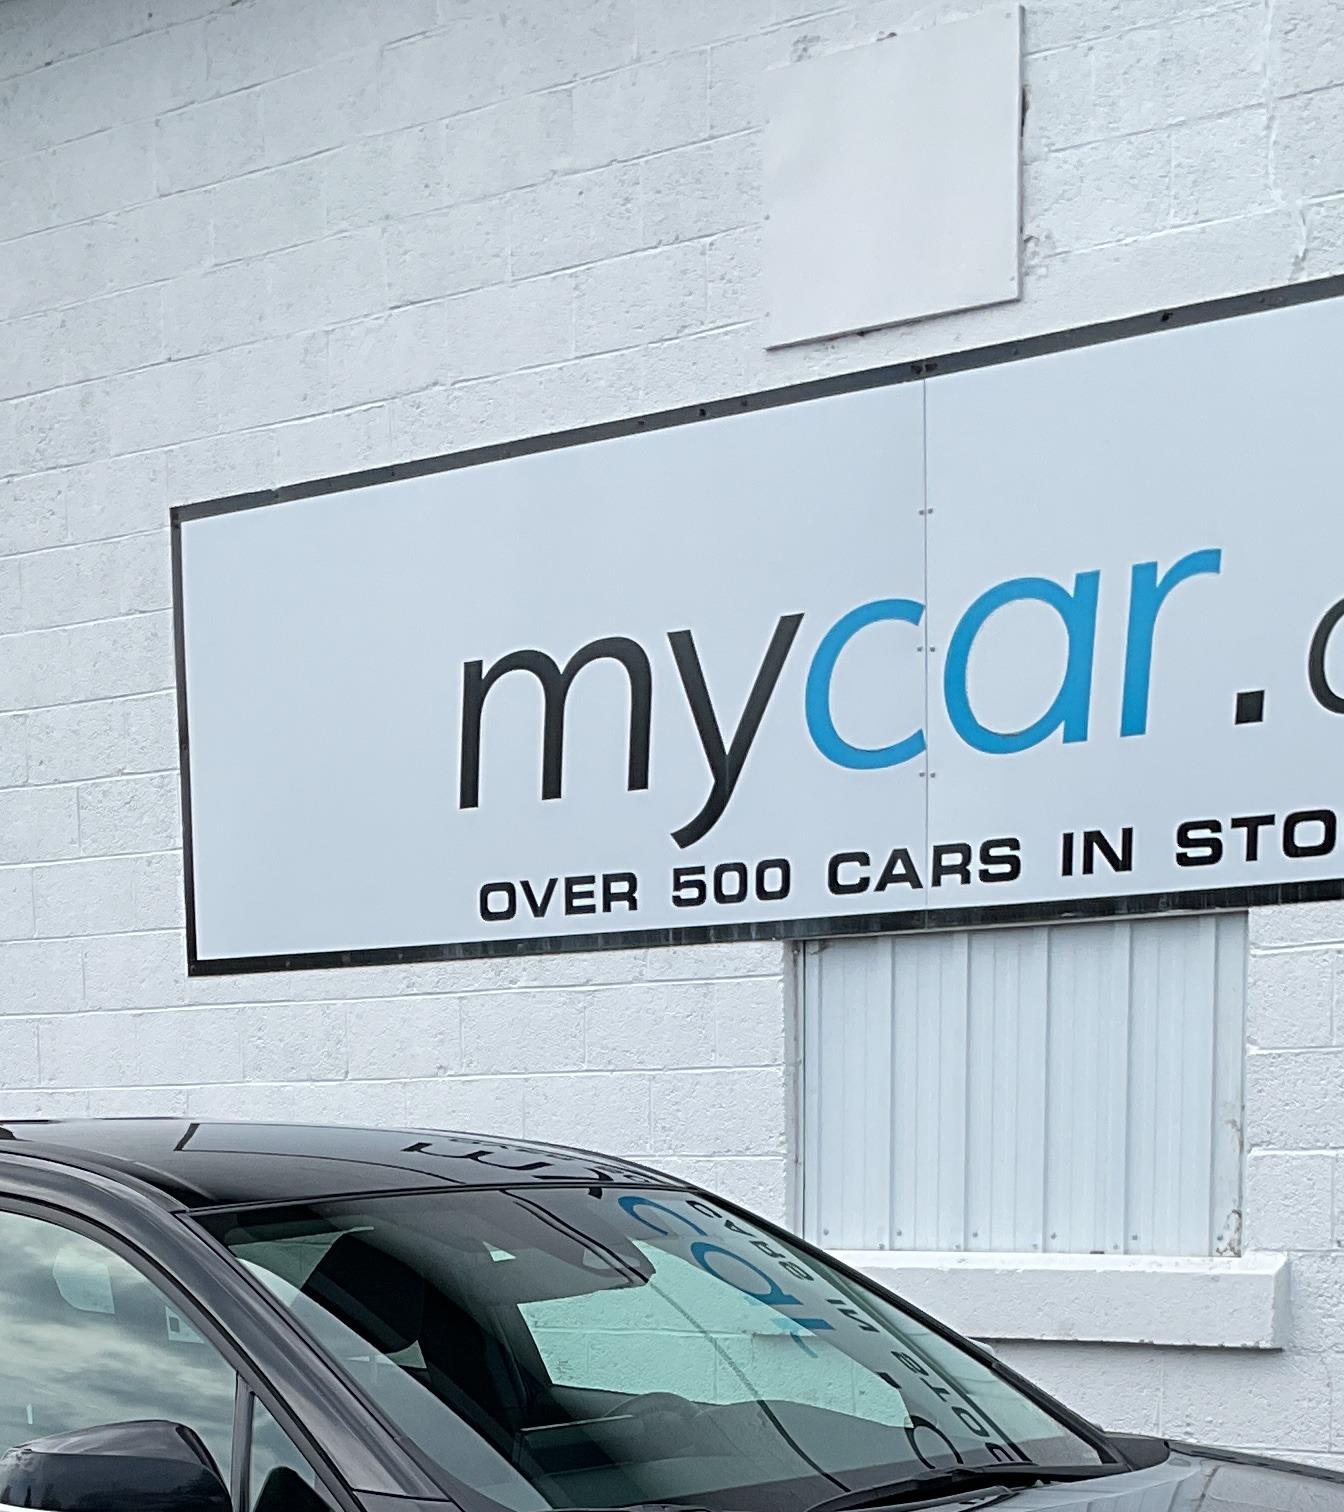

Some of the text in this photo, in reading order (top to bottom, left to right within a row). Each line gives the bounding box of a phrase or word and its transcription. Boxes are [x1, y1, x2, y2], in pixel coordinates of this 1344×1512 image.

[479, 871, 639, 922] OVER
[671, 859, 792, 908] 500
[827, 837, 1022, 896] CARS
[1061, 827, 1135, 877] IN
